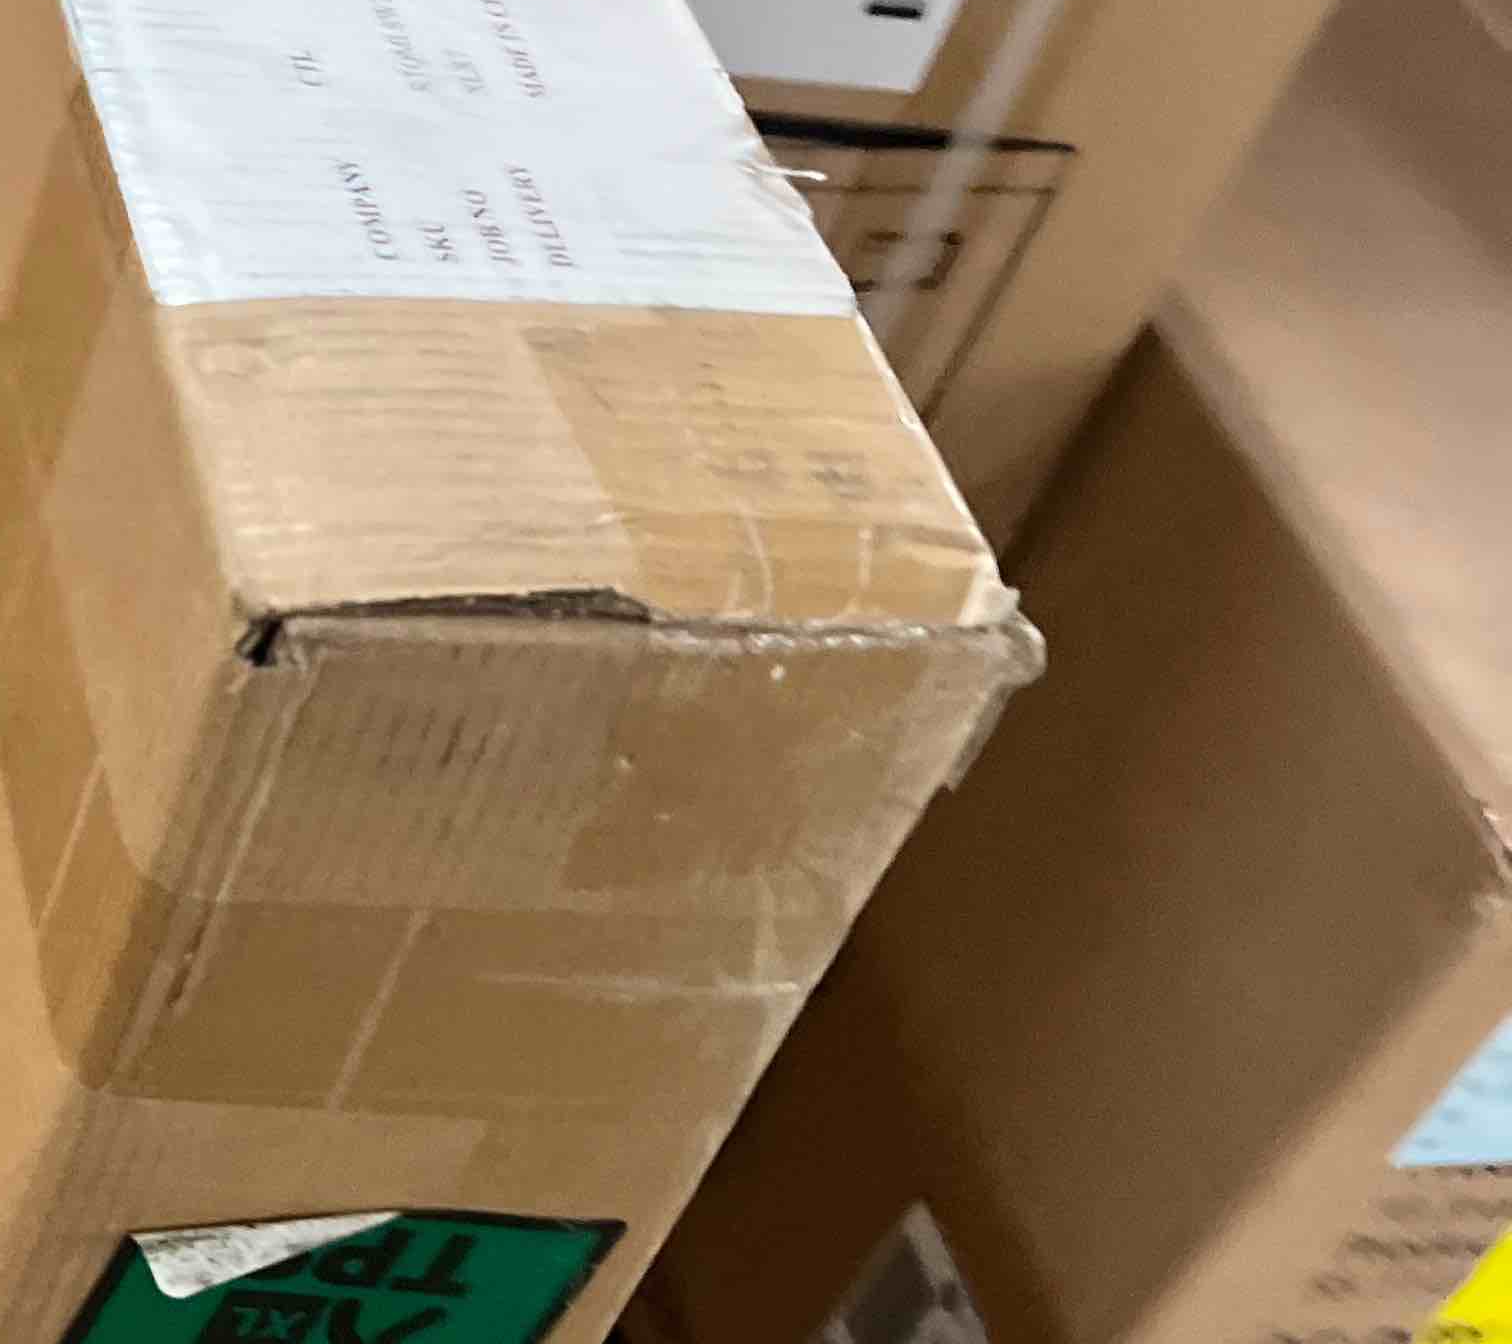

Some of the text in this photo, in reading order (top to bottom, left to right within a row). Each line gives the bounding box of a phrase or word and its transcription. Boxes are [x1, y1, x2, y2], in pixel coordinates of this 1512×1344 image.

[329, 157, 399, 261] COMPANY
[417, 219, 456, 264] SKU
[479, 225, 521, 265] JOB
[505, 163, 580, 268] DELIVERY
